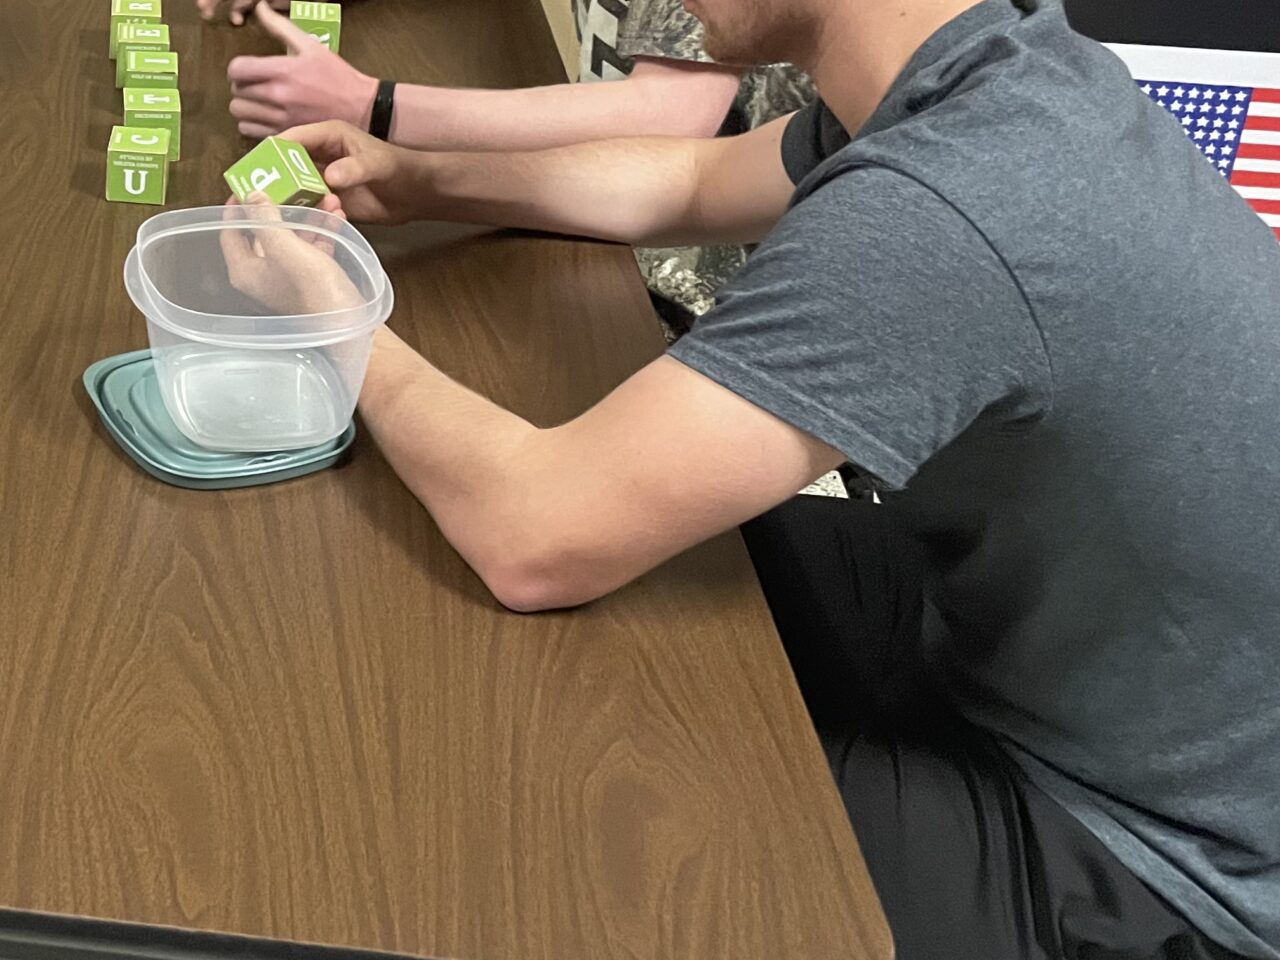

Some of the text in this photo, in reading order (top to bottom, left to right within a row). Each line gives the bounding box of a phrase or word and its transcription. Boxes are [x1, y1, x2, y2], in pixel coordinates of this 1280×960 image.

[135, 29, 160, 37] E
[143, 94, 171, 104] T
[123, 169, 148, 195] U
